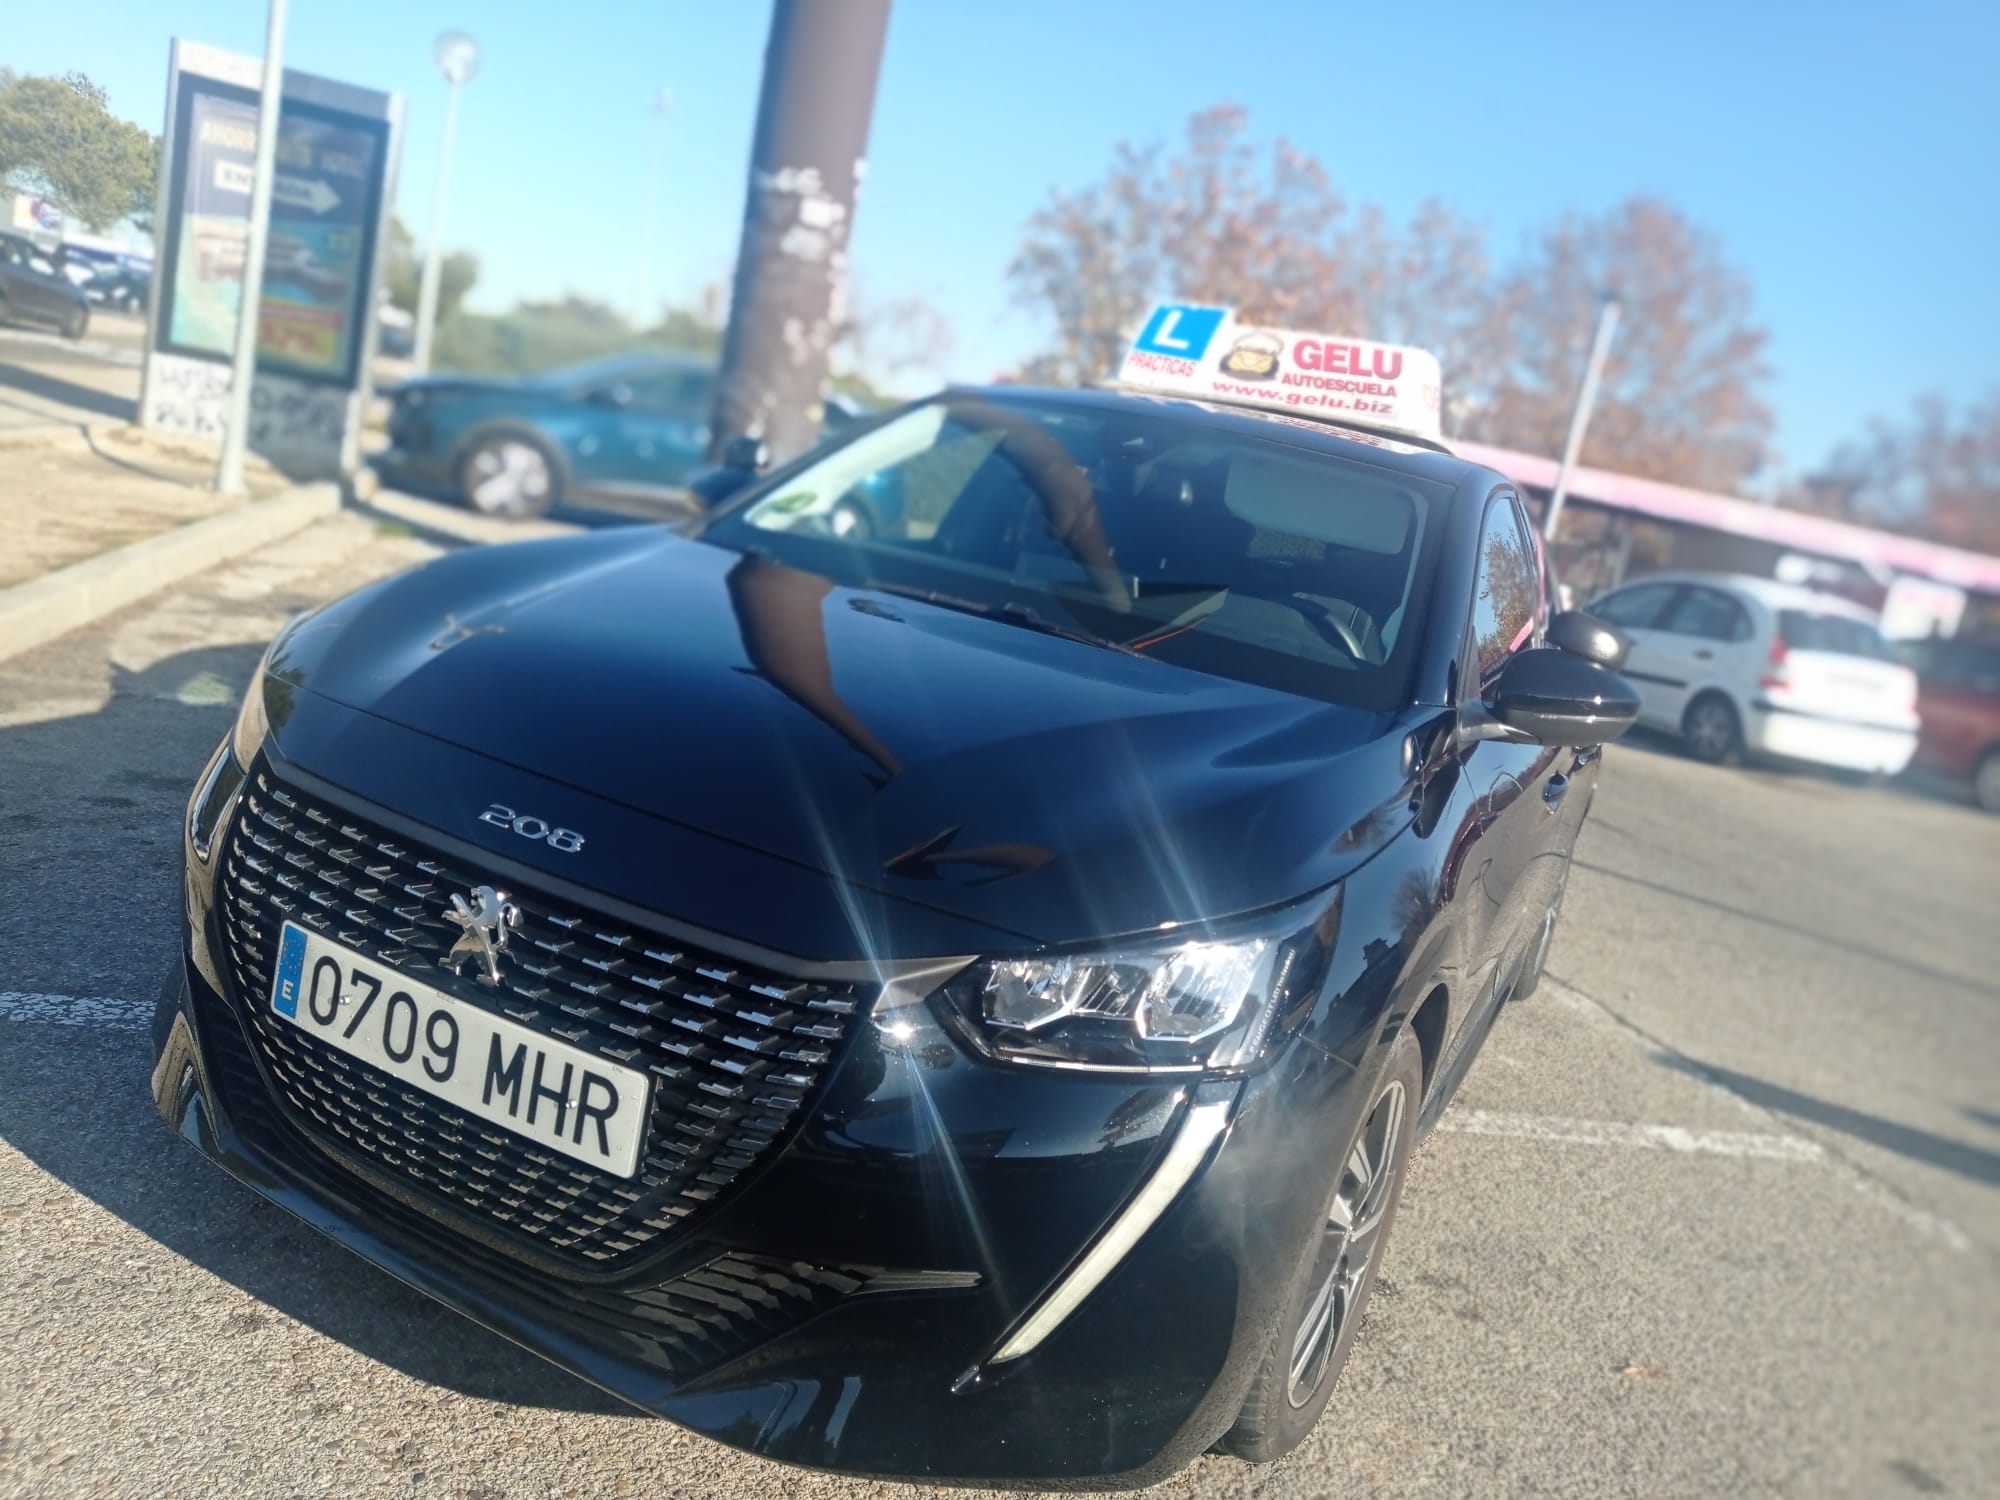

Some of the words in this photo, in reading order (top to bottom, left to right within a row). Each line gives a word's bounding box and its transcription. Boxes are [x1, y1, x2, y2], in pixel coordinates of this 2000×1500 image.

[1154, 309, 1189, 350] L
[1293, 338, 1403, 380] GELU
[1211, 381, 1394, 414] www.gelu.biz
[1281, 372, 1397, 397] AUTOESCUELA
[478, 804, 585, 853] 208
[281, 979, 294, 1001] E
[309, 956, 459, 1082] 0709
[481, 1031, 620, 1157] MHR
